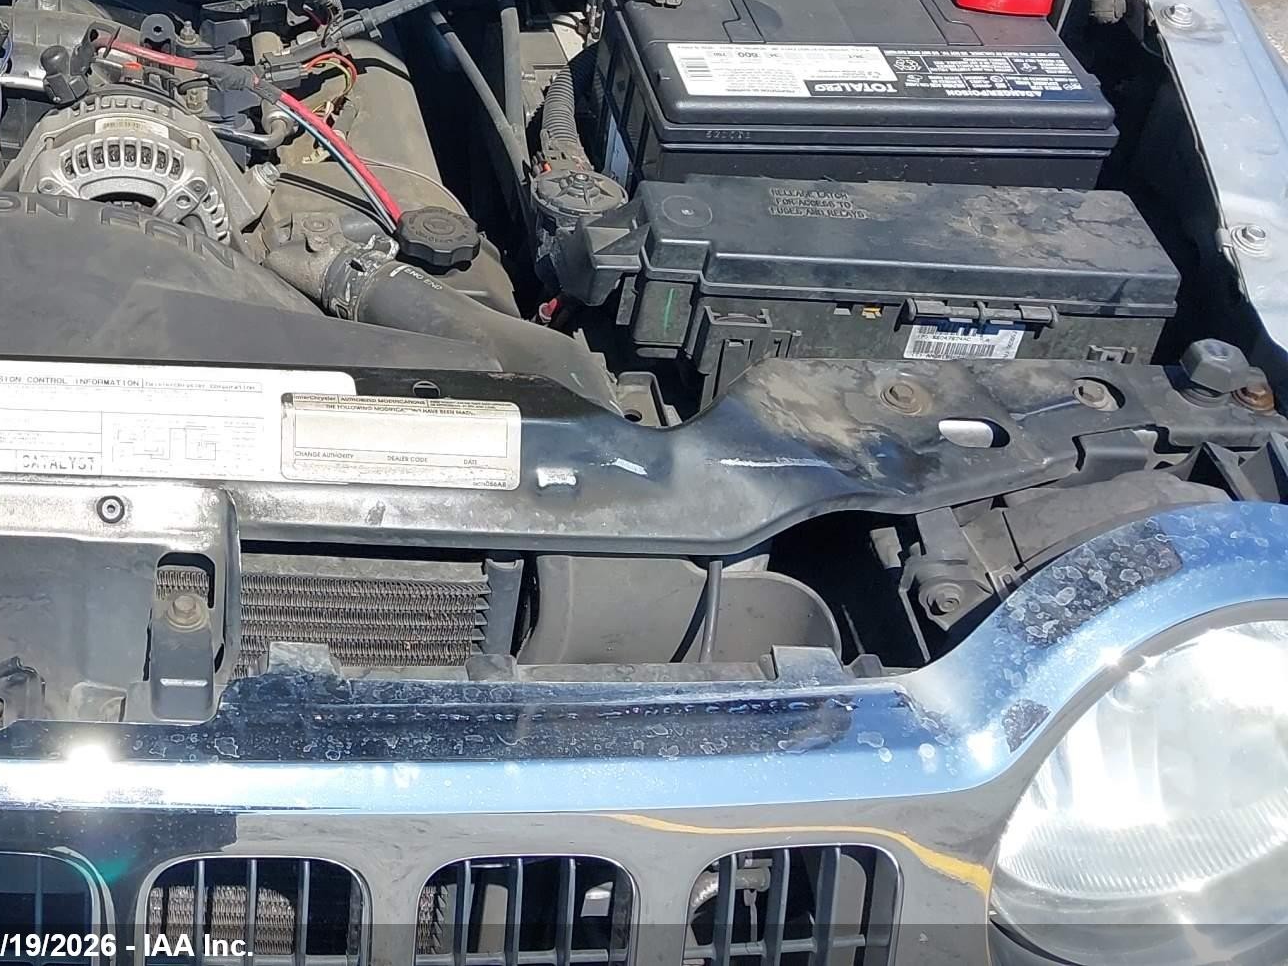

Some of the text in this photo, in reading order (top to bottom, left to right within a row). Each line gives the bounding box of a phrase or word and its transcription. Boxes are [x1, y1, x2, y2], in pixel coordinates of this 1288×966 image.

[99, 206, 236, 270] FAN
[26, 376, 67, 384] CONTROL
[75, 378, 140, 386] INFORMATION
[22, 454, 94, 471] CATALYST
[294, 450, 320, 458] CHANGE
[322, 452, 354, 460] AUTHORITY
[387, 455, 409, 463] DEALER
